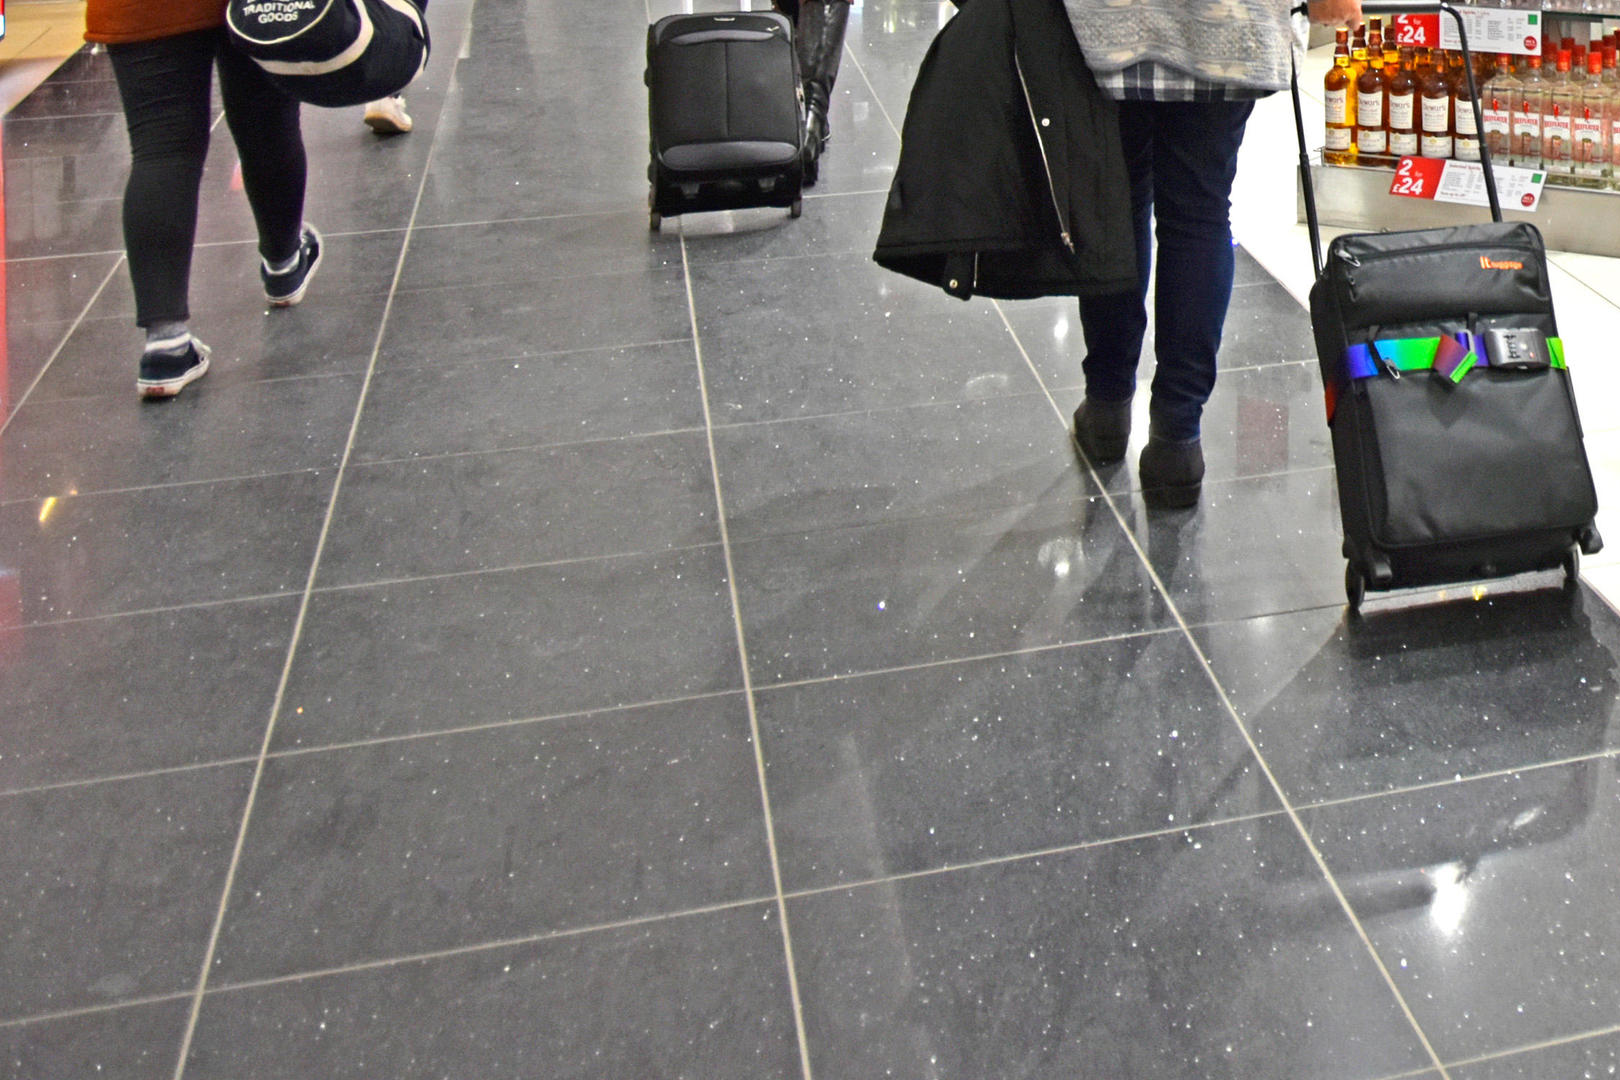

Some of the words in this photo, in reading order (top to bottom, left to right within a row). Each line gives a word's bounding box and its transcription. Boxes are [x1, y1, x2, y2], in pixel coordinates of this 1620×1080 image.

[243, 0, 316, 16] TRADITIONAL
[258, 11, 298, 24] GOODS
[1397, 25, 1425, 44] £24
[1402, 159, 1413, 176] 2
[1392, 177, 1422, 195] £24
